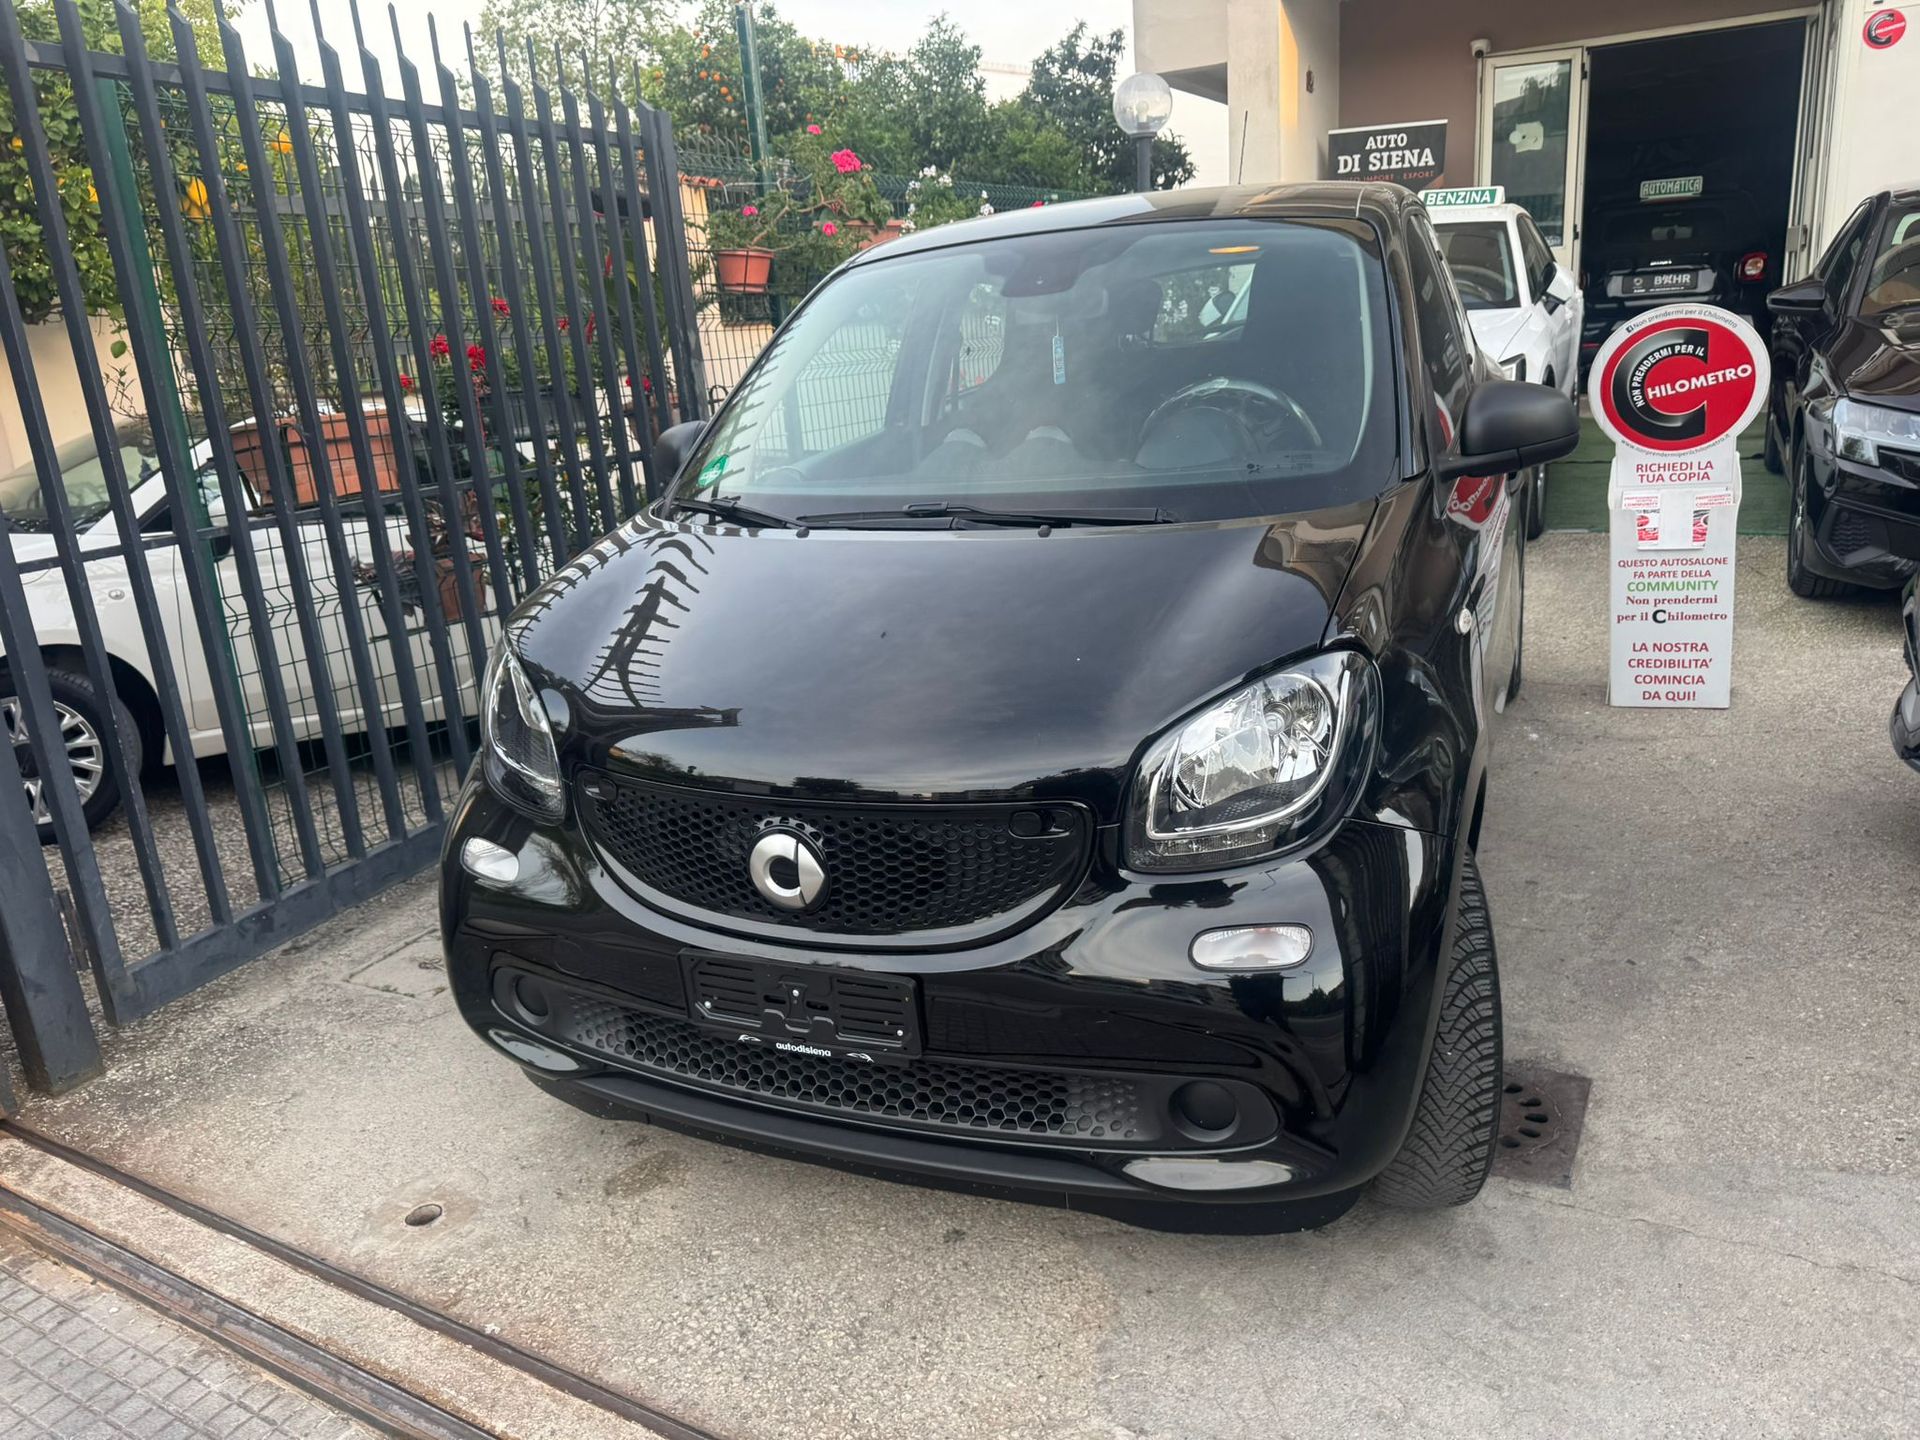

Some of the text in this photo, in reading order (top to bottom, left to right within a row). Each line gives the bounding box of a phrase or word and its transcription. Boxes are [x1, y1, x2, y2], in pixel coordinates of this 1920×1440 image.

[1365, 133, 1407, 150] AUTO
[1337, 148, 1435, 174] DI SIENA
[1643, 179, 1700, 196] AUTOMATICA
[1426, 191, 1491, 205] BENZINA
[1647, 308, 1684, 322] prendermi
[1631, 344, 1705, 408] NON PRENDERMI PER IL
[1636, 460, 1714, 473] RICHIEDI LA
[1638, 471, 1711, 484] TUA COPIA
[1618, 557, 1729, 569] QUESTO AUTOSALONE
[1633, 569, 1711, 579] FA PARTE DELLA
[1627, 580, 1718, 592] COMMUNITY
[1626, 595, 1718, 607] Non prendermi
[1616, 609, 1728, 624] per il Chilometro
[1632, 642, 1709, 652] LA NOSTRA
[1628, 658, 1712, 668] CREDIBILITA'
[1634, 675, 1705, 685] COMINCIA
[1642, 691, 1696, 702] DA QUI!
